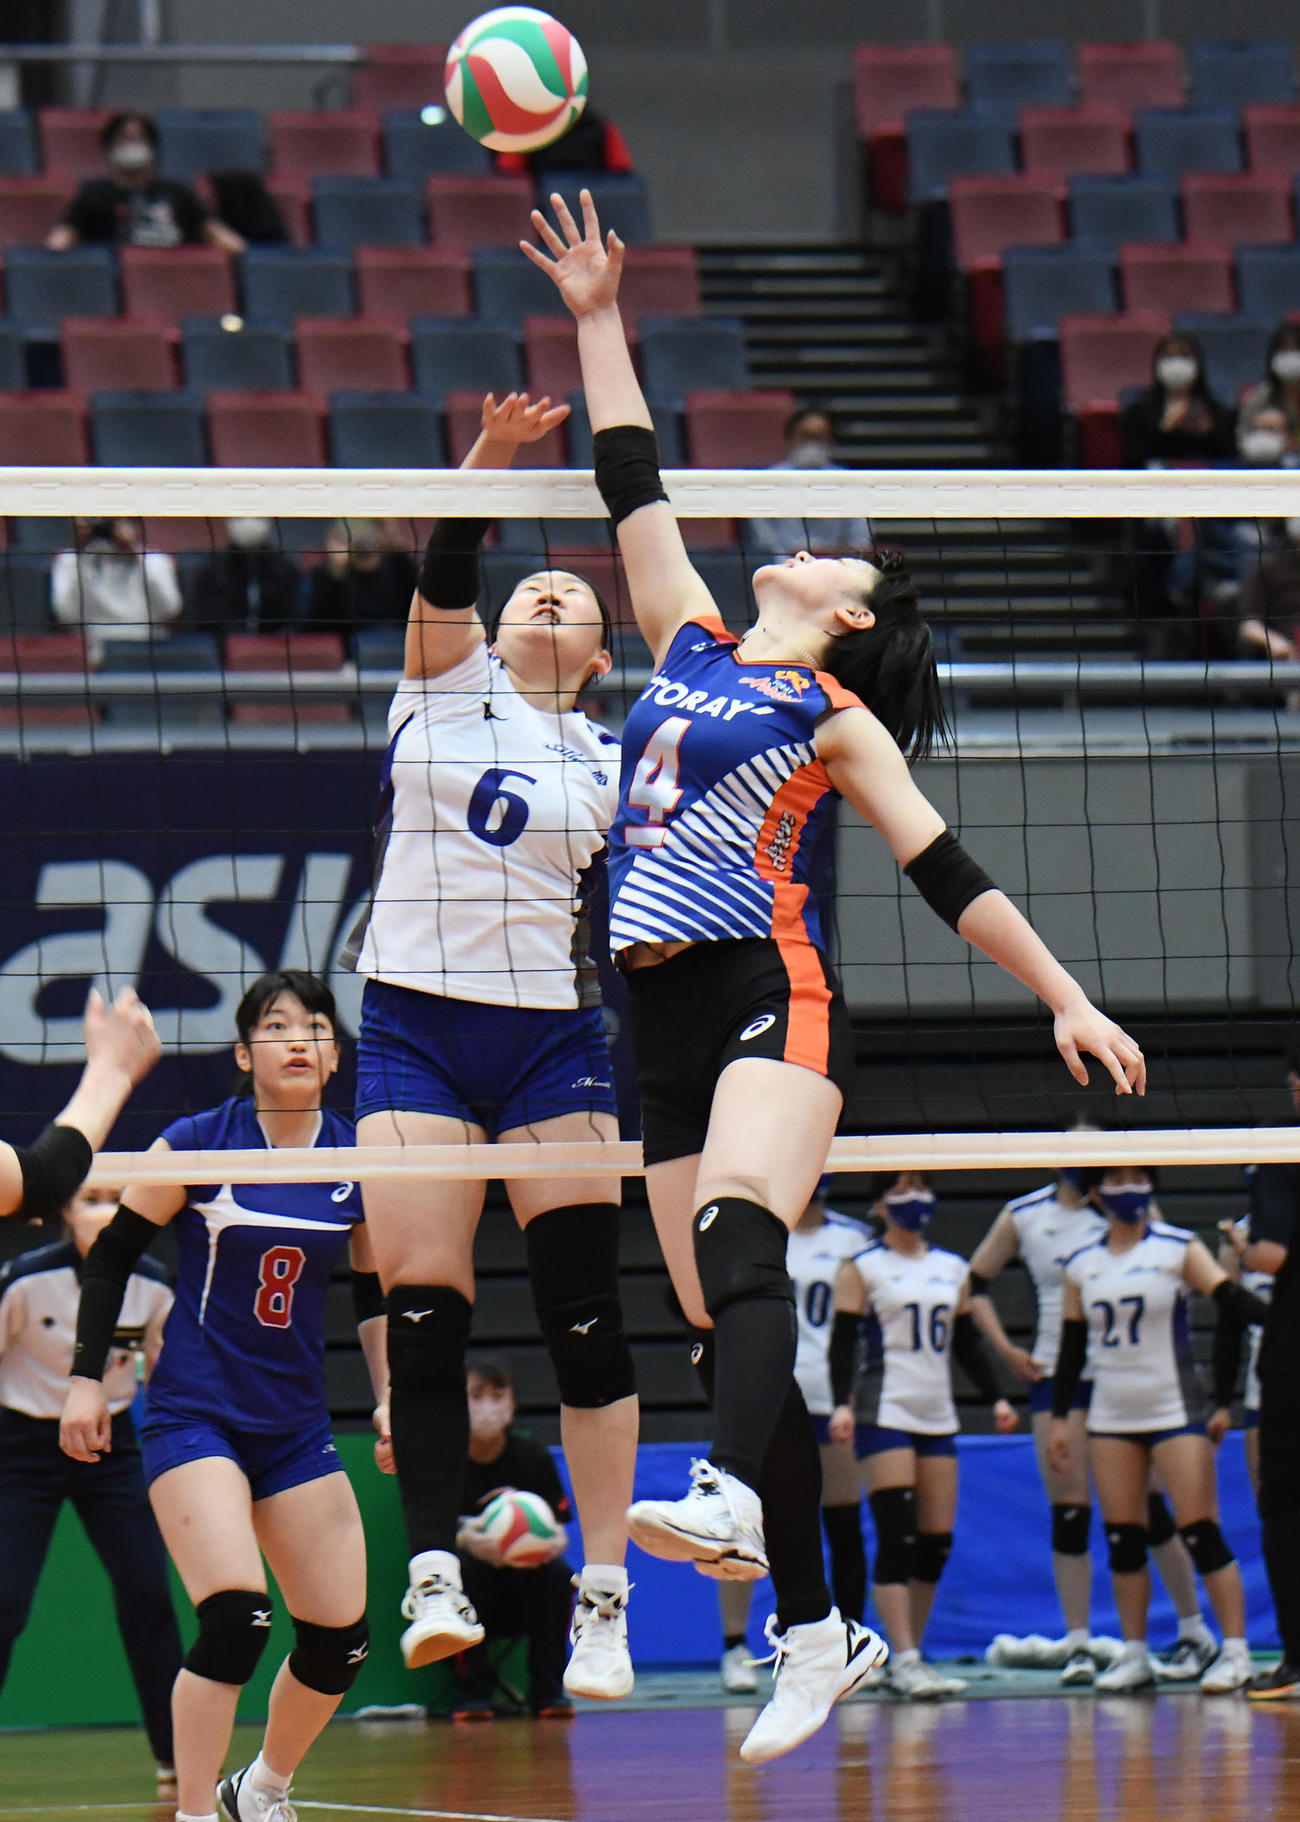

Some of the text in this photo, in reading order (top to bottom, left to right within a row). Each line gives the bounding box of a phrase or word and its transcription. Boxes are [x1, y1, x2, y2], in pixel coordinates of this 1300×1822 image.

[467, 767, 538, 848] 6
[627, 716, 692, 825] 4
[253, 1245, 306, 1329] 8
[1092, 1296, 1144, 1347] 27
[902, 1303, 951, 1353] 16
